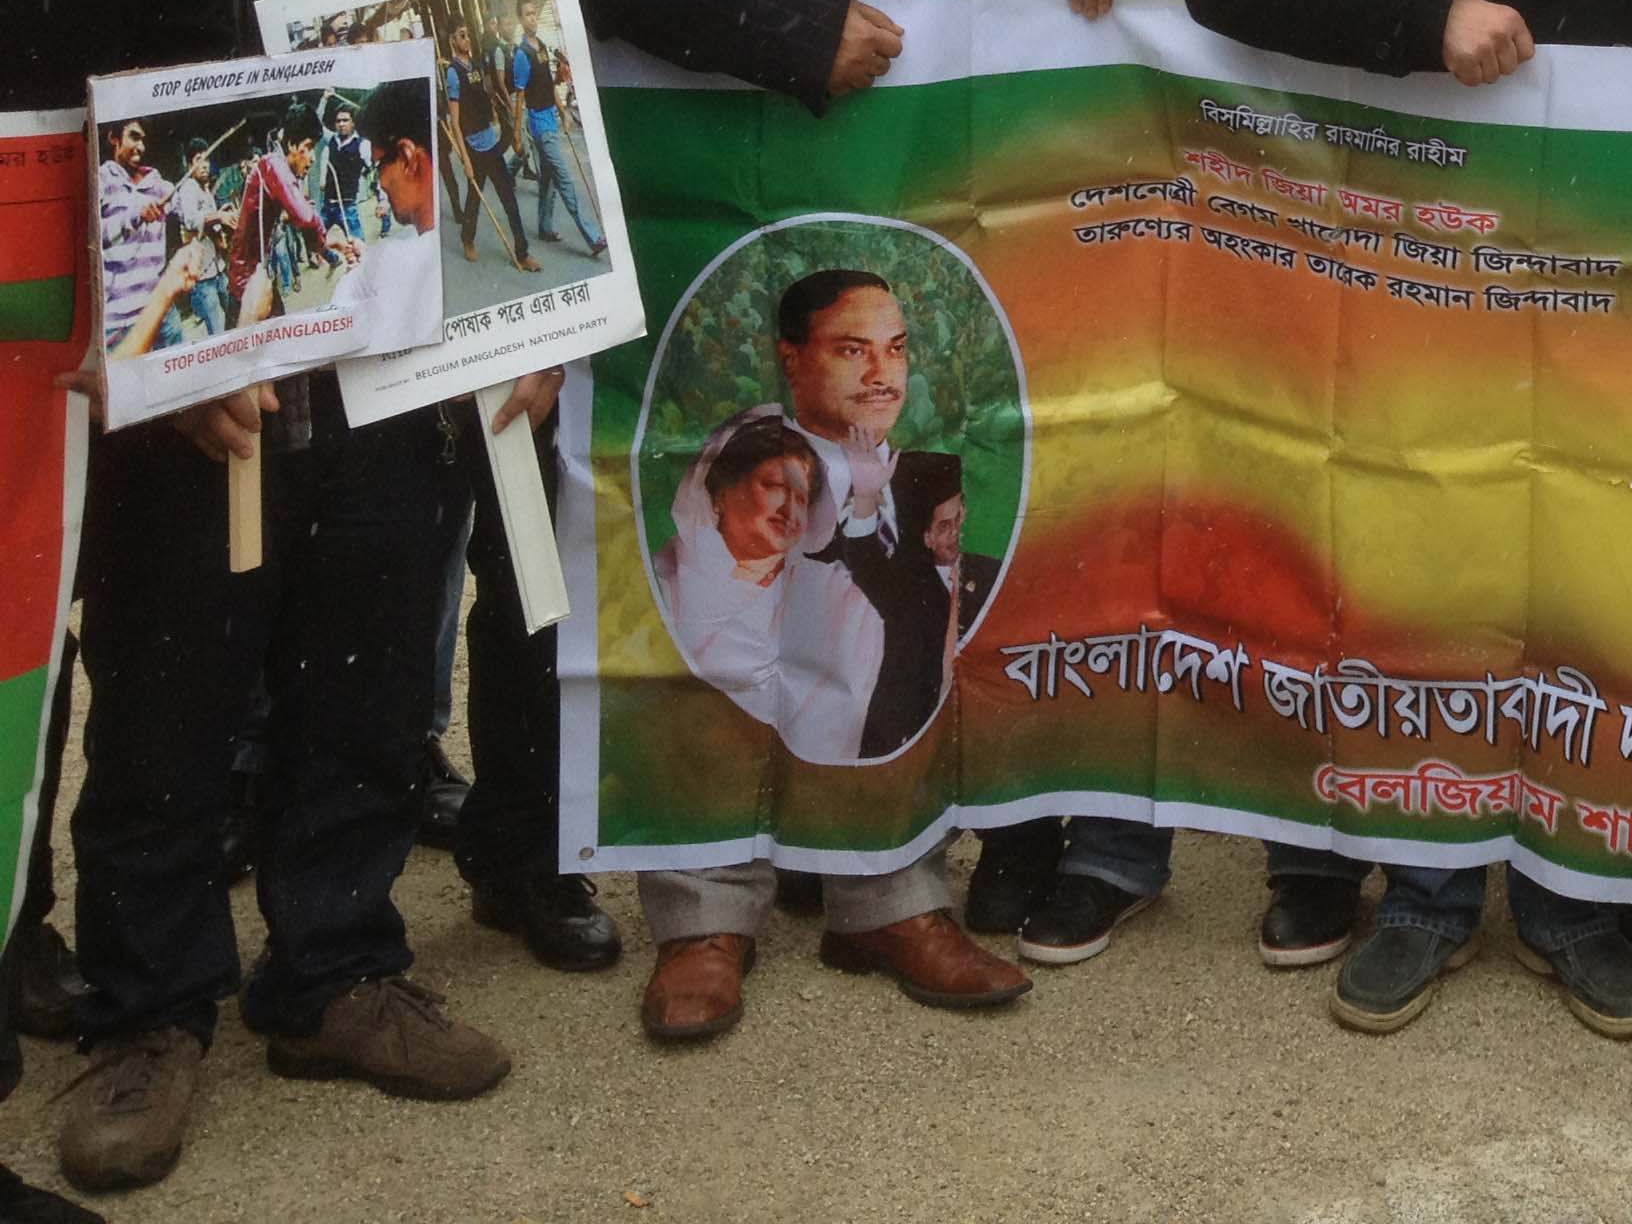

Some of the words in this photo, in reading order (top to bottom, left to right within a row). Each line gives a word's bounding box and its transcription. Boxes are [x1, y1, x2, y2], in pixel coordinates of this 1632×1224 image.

[152, 80, 181, 98] STOP
[184, 72, 245, 96] GENOCIDE
[246, 71, 259, 85] IN
[262, 60, 336, 83] BANGLADESH
[1325, 123, 1400, 157] রাহমানির
[1406, 136, 1468, 168] রাহীম
[1184, 149, 1254, 184] শহীদ
[1262, 168, 1328, 206] জিয়া
[1337, 188, 1403, 223] অমর
[1413, 201, 1500, 234] হউক
[1070, 176, 1198, 209] দেশনেত্রী
[1207, 195, 1279, 226] বেগম
[1392, 232, 1462, 271] জিয়া
[1472, 245, 1623, 277] জিন্দাবাদ
[1200, 226, 1297, 269] অহংকার
[1305, 252, 1378, 291] তারেক
[1386, 276, 1475, 311] রহমান
[1482, 284, 1615, 313] জিন্দাবাদ
[164, 353, 195, 374] STOP
[196, 337, 249, 364] GENOCIDE
[251, 333, 264, 347] IN
[264, 316, 353, 344] BANGLADESH
[444, 311, 492, 343] পোষাক
[497, 301, 525, 325] পরে
[529, 292, 556, 313] এরা
[558, 282, 591, 306] কারা
[415, 360, 460, 381] BELGIUM
[461, 340, 526, 368] BANGLADESH
[529, 327, 578, 347] NATIONAL
[578, 316, 608, 332] PARTY
[1000, 623, 1251, 712] বাংলাদেশ
[1260, 659, 1609, 765] জাতীয়তাবাদী
[1316, 760, 1565, 832] বেলজিয়াম
